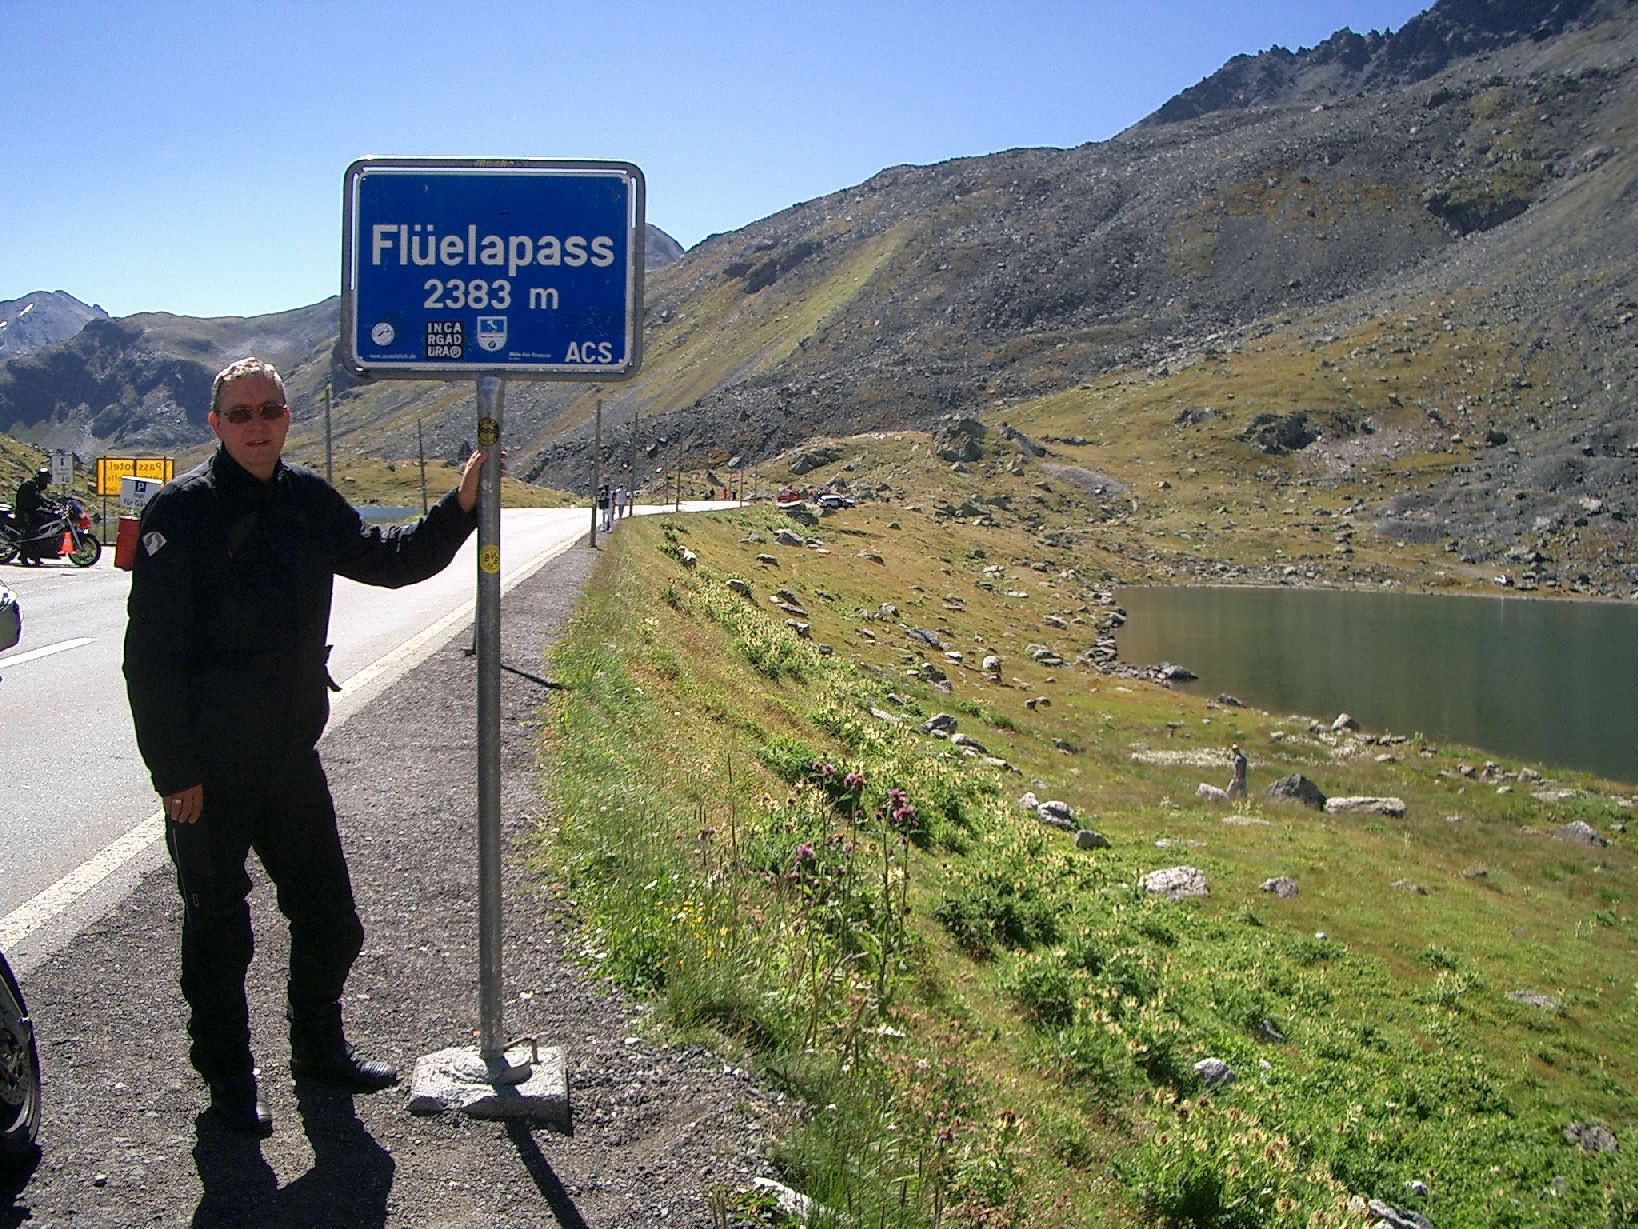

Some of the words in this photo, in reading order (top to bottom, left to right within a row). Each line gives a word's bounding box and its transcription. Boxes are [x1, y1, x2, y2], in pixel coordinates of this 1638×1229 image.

[371, 223, 615, 277] Flüelapass
[423, 279, 512, 310] 2383
[528, 287, 559, 310] m
[428, 322, 462, 333] INCA
[428, 334, 462, 345] RGAD
[564, 341, 613, 363] ACS
